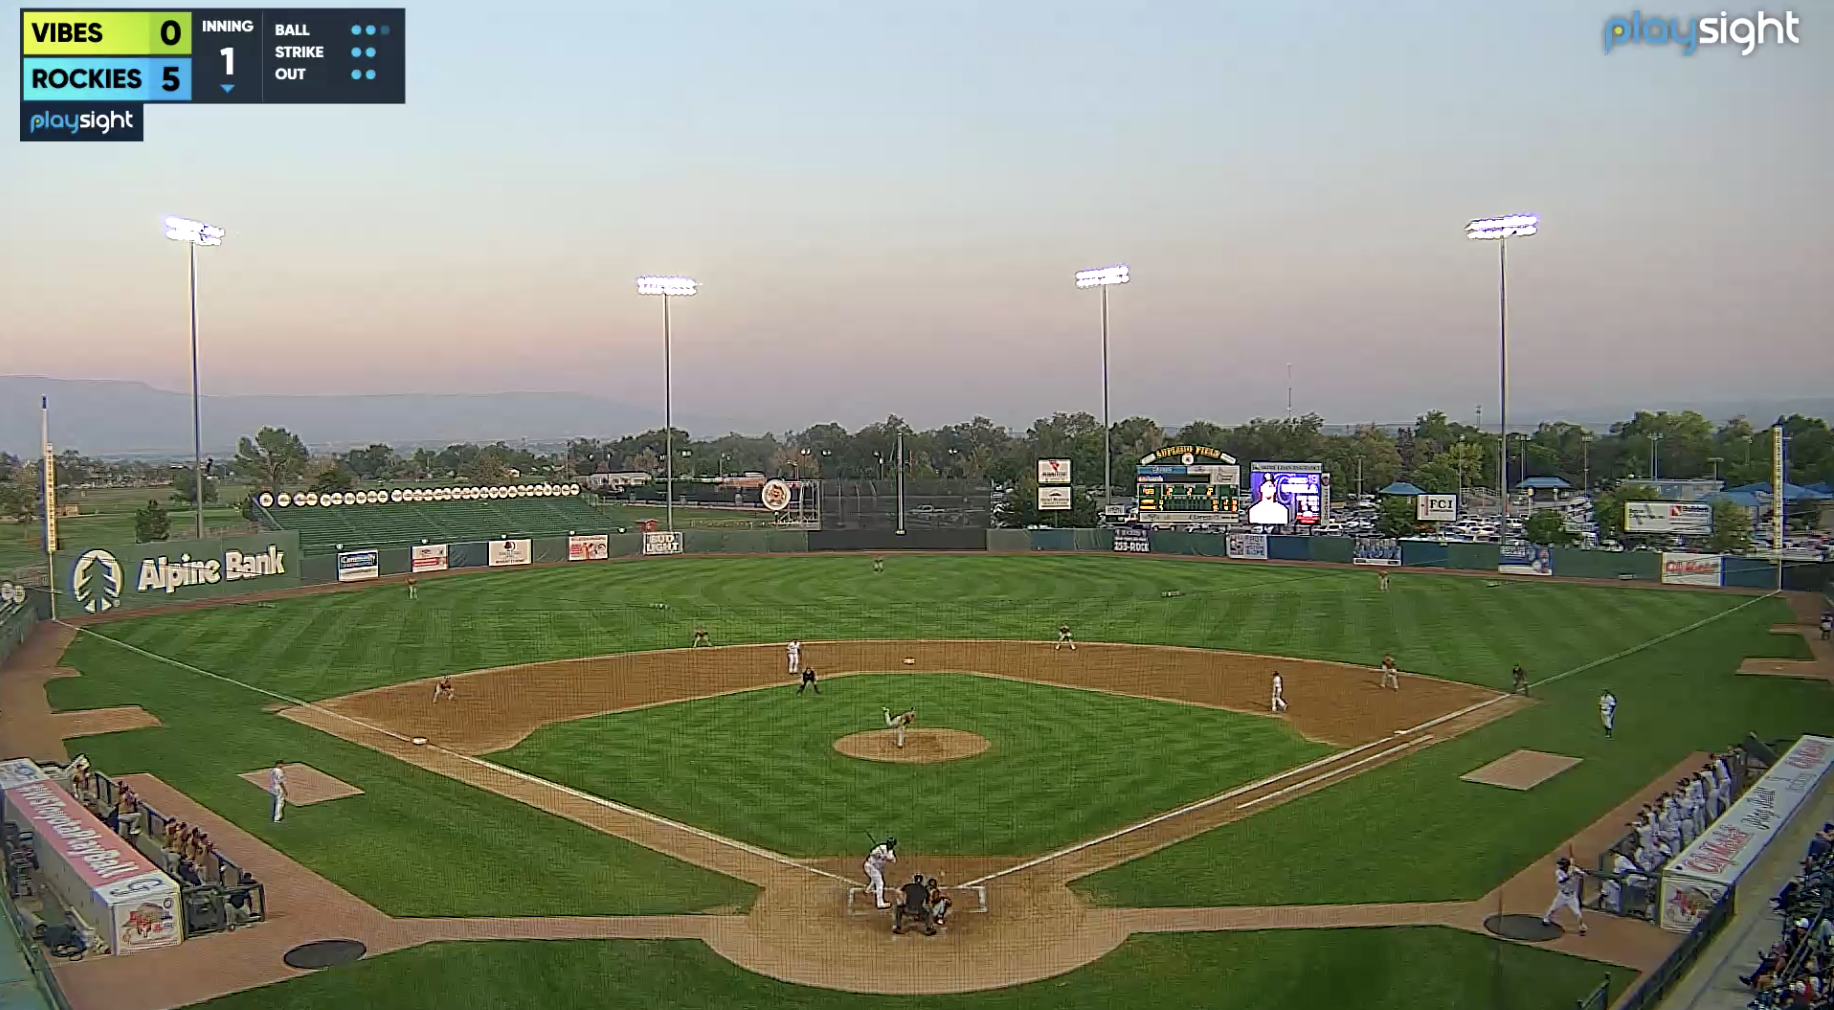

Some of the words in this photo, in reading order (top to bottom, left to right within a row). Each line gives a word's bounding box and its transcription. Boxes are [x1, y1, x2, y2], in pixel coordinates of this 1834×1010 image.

[1430, 499, 1453, 509] FCI
[651, 534, 675, 544] BUD
[647, 542, 679, 552] LIGHT
[138, 554, 221, 593] Alpine
[225, 544, 286, 581] Bank
